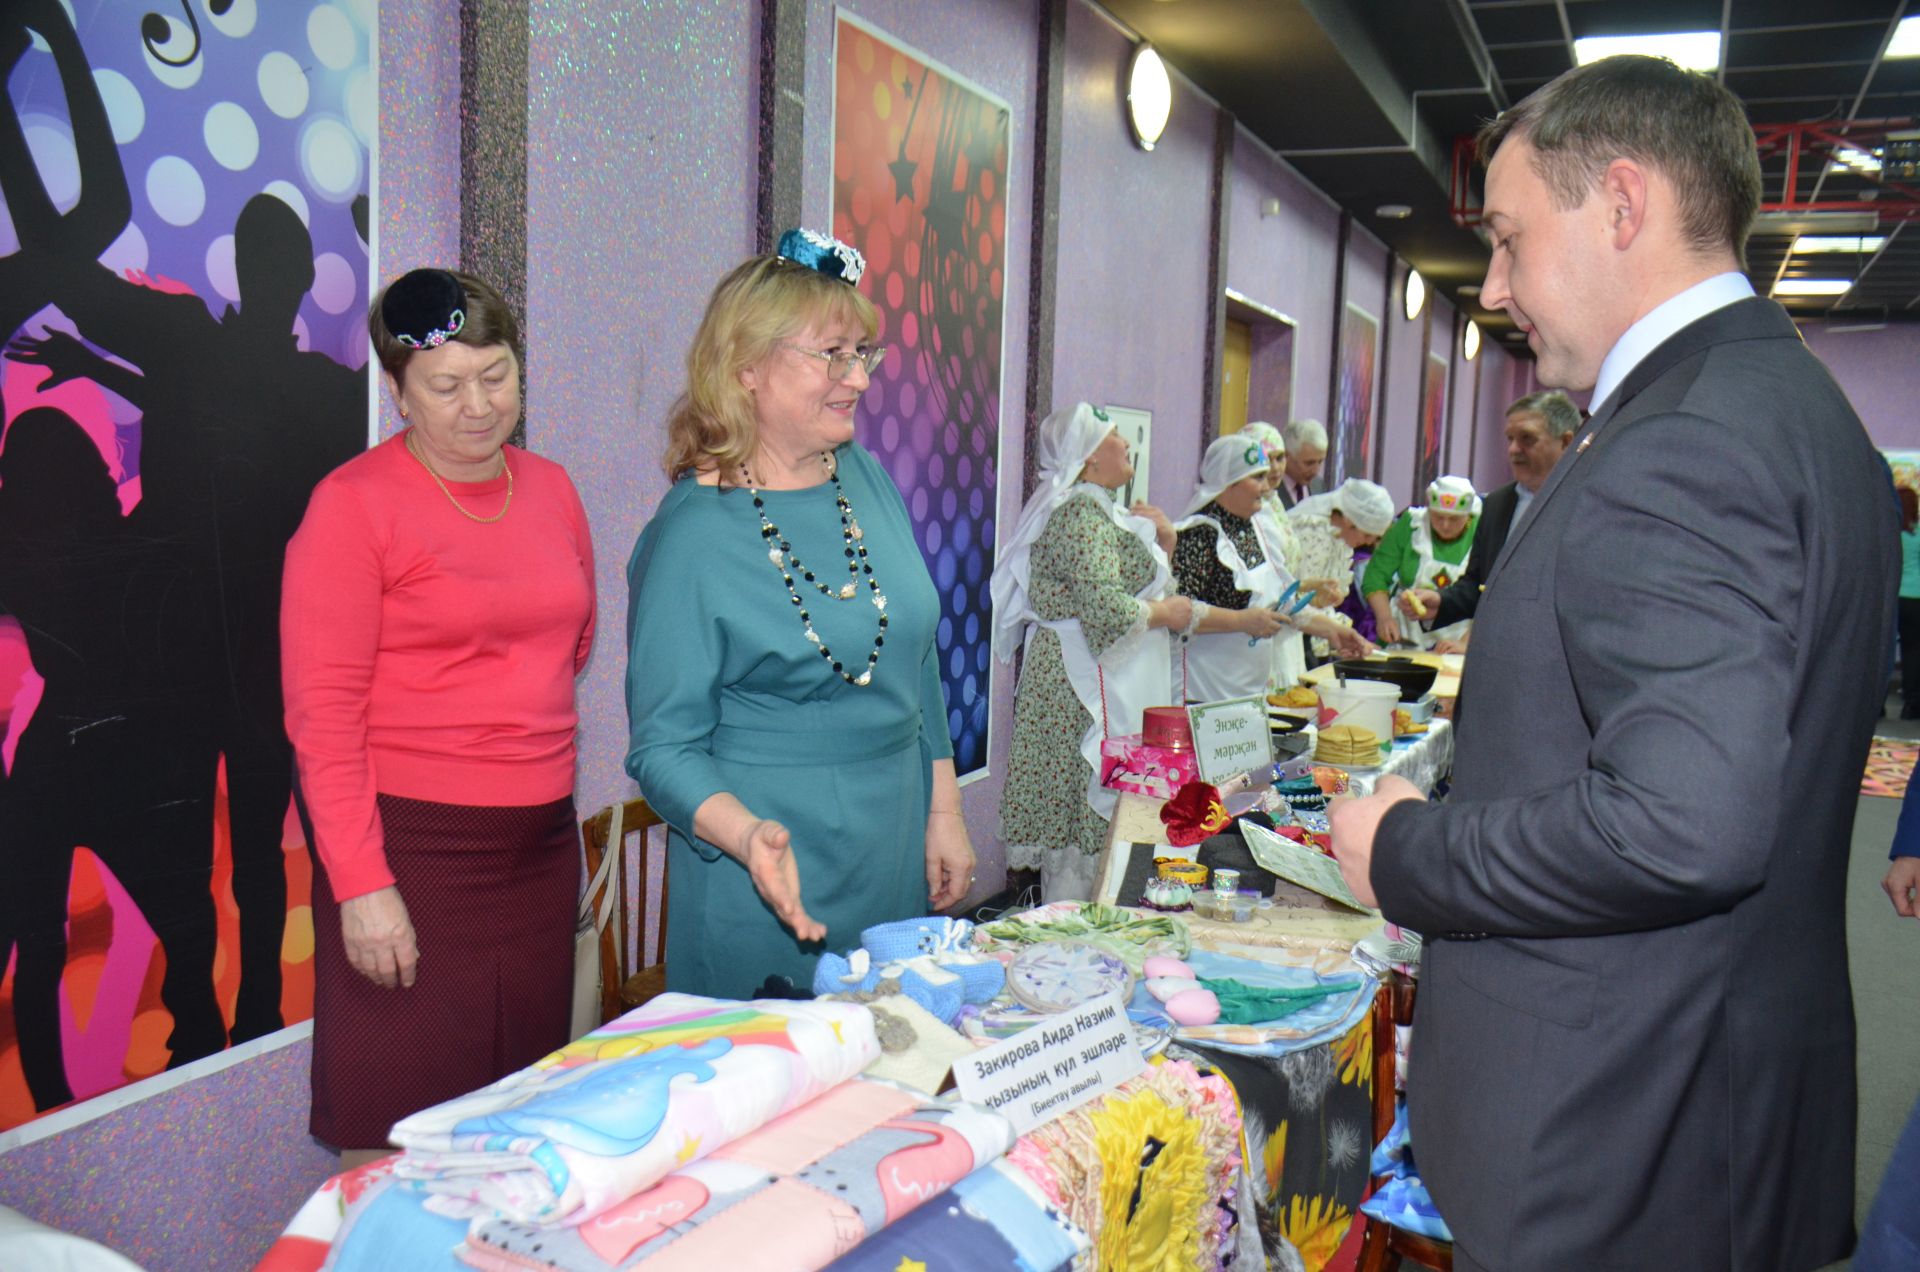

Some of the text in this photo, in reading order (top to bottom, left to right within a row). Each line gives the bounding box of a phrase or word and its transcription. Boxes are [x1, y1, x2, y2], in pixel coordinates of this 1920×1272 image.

[975, 1005, 1116, 1079] Закирова Аида Назим
[1080, 1031, 1127, 1064] эшләре
[1031, 1070, 1102, 1117] (Биектау авылы)
